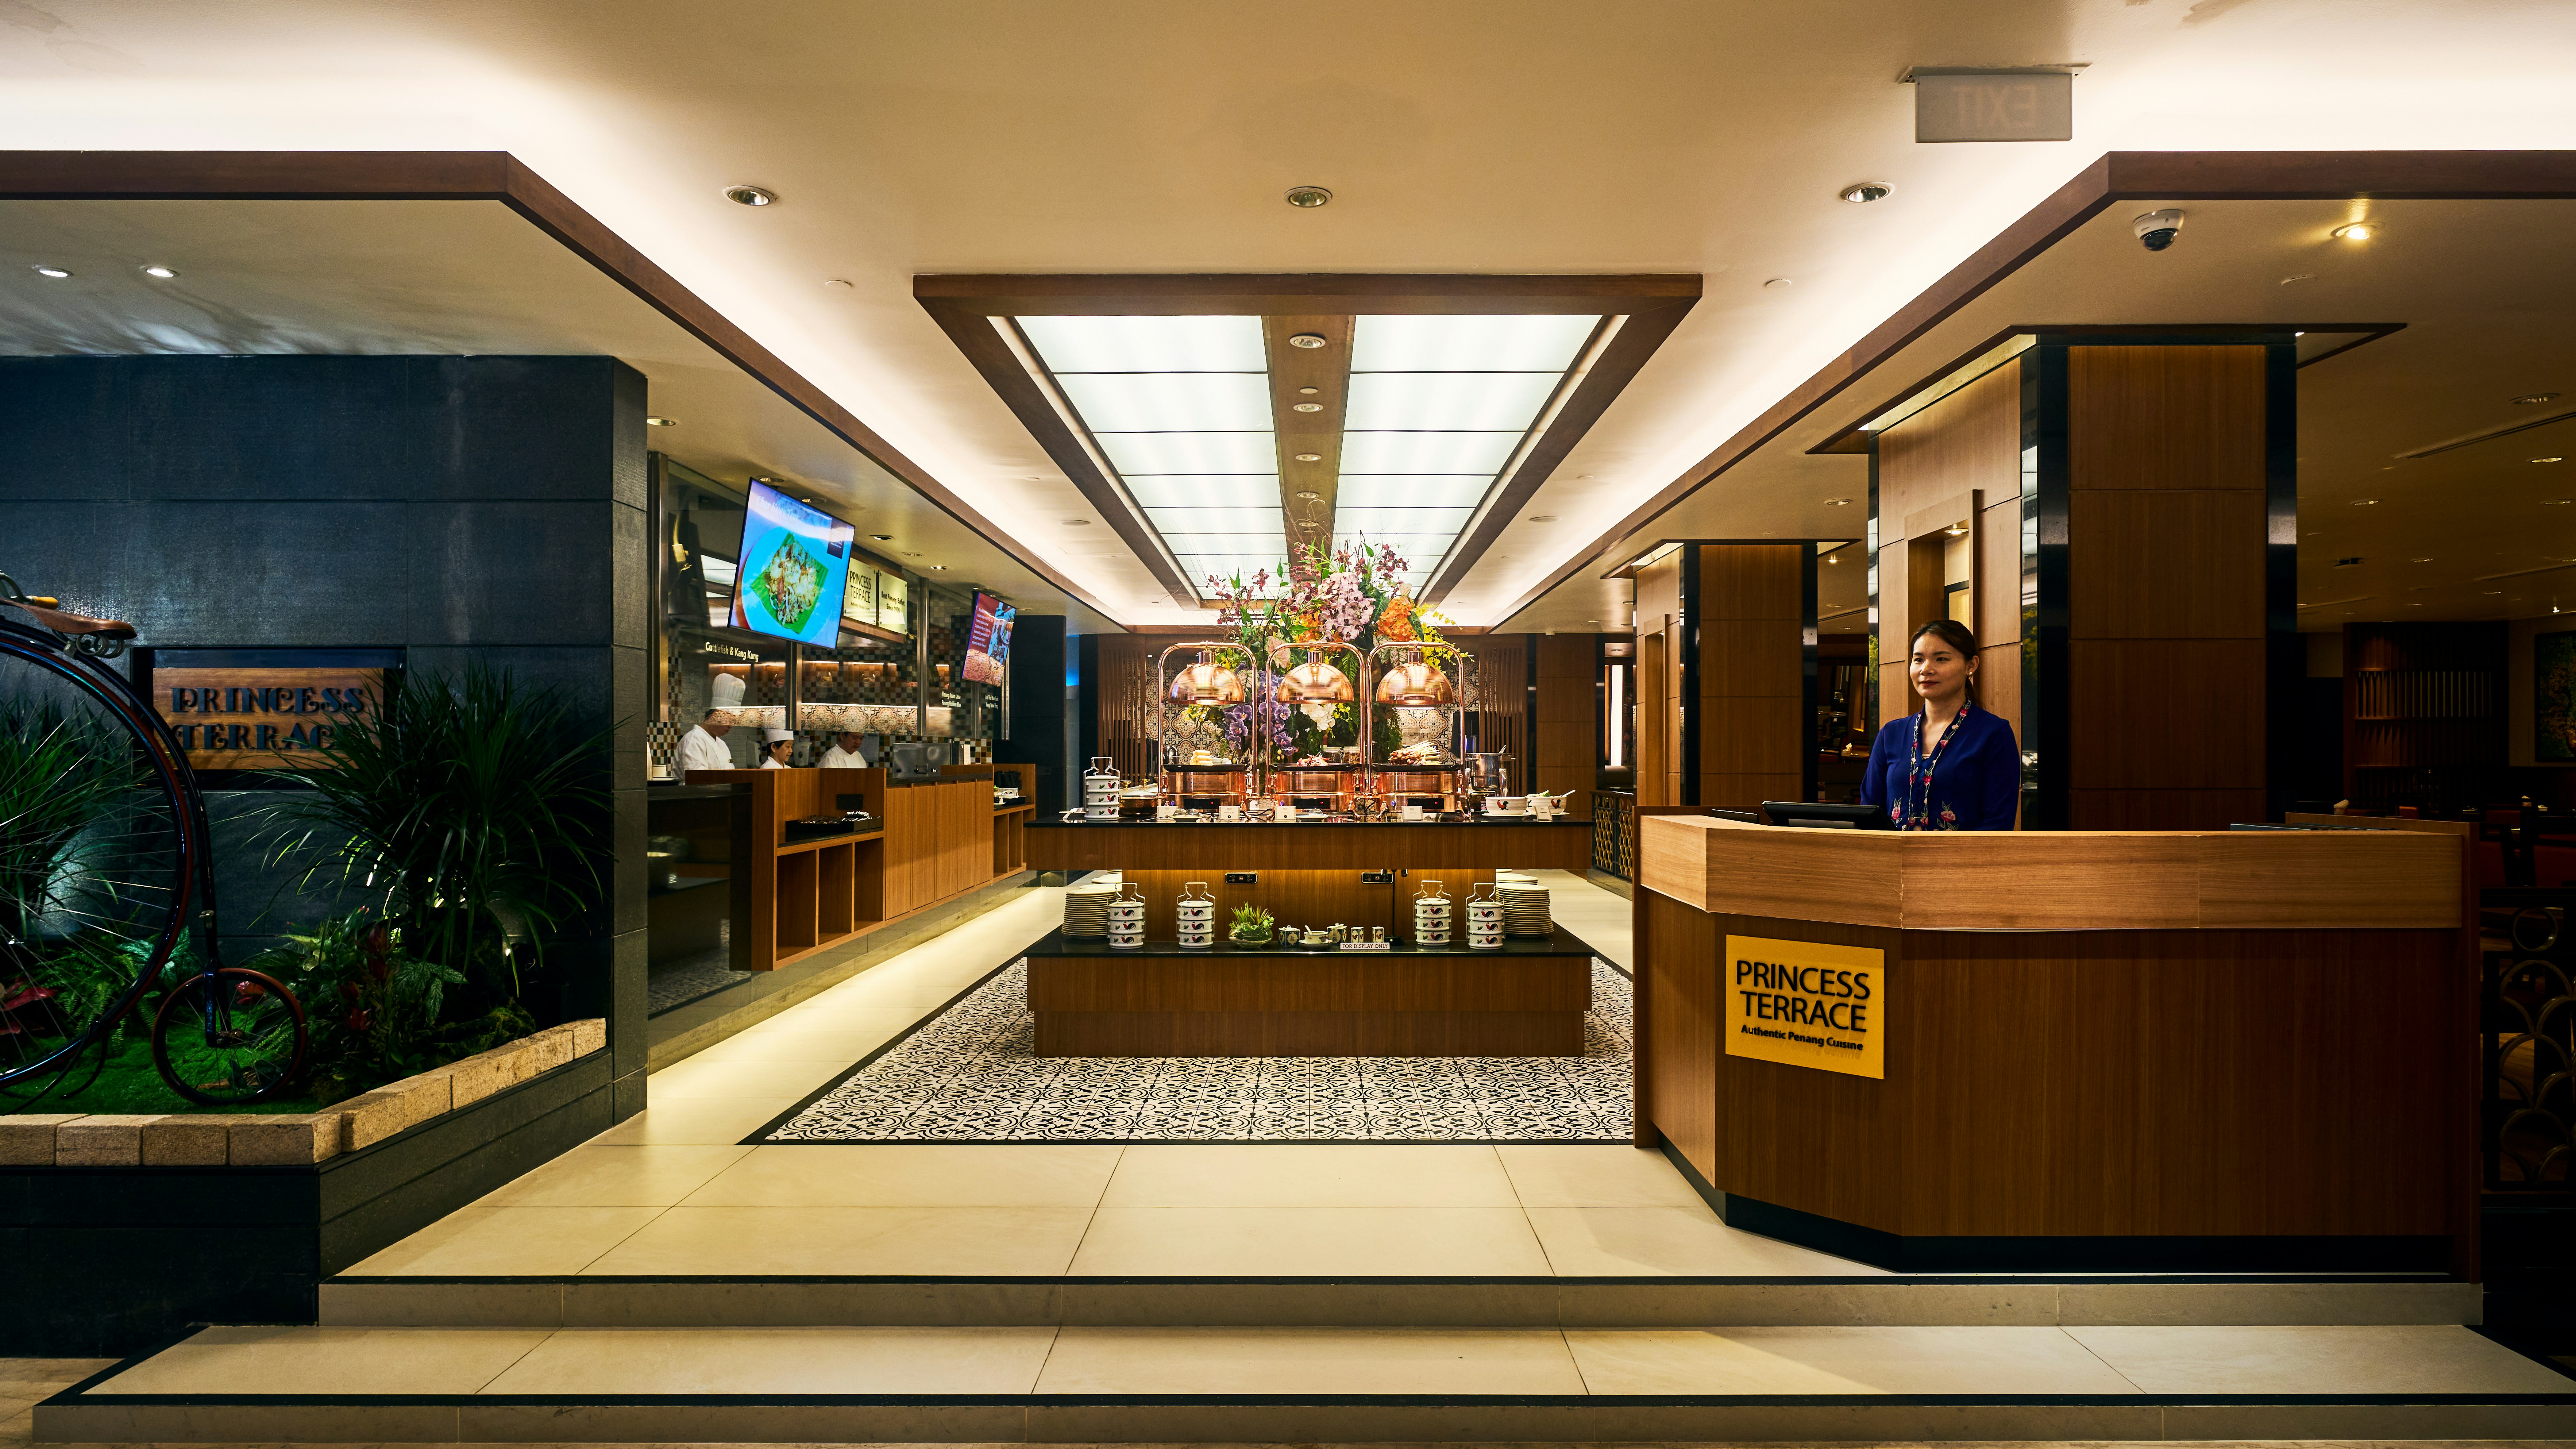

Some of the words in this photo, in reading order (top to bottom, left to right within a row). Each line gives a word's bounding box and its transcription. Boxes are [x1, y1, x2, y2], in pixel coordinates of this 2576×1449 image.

[850, 571, 871, 590] PRINCESS
[851, 585, 870, 603] TERRACE
[705, 641, 729, 655] Cuttlefish
[730, 647, 734, 655] &
[735, 648, 747, 660] Kang
[747, 650, 759, 663] Kung
[172, 687, 364, 714] PRINCESS
[171, 722, 356, 750] TERRAC
[1737, 960, 1870, 1000] PRINCESS
[1740, 990, 1867, 1033] TERRACE
[1741, 1025, 1786, 1040] Authentic
[1788, 1031, 1824, 1047] Penang
[1826, 1037, 1863, 1051] Cuisine
